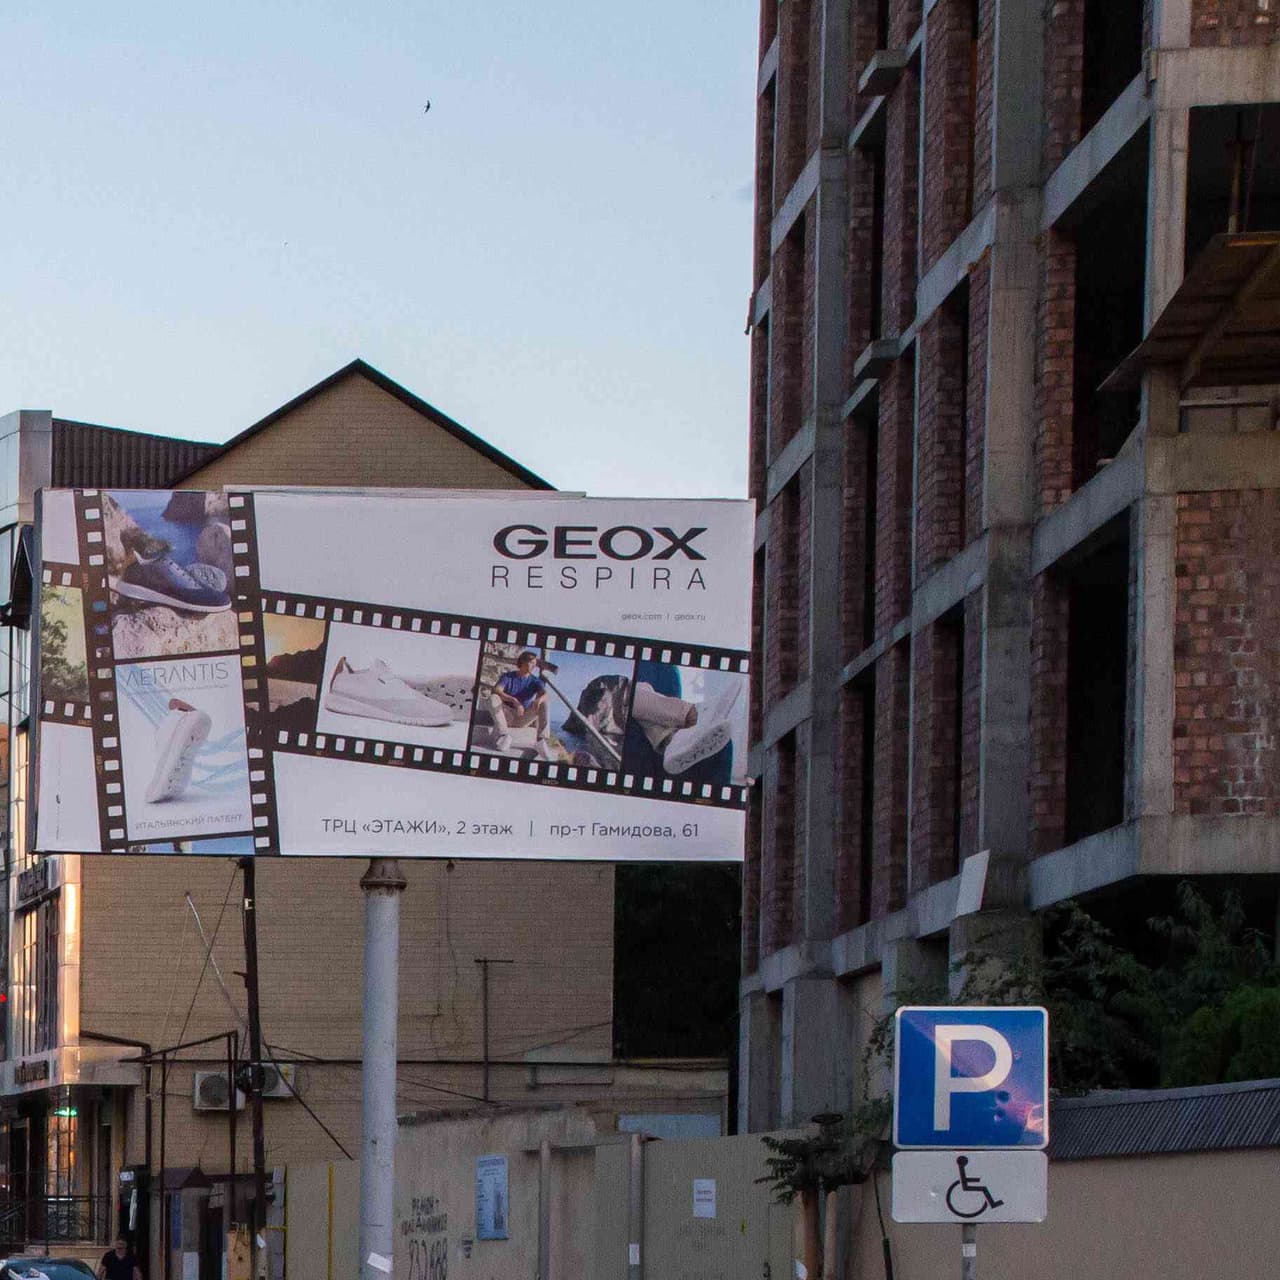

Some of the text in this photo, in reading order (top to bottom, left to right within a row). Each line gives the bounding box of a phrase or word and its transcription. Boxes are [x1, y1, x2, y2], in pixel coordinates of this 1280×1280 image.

[493, 524, 708, 561] GEOX
[492, 565, 706, 590] RESPIRA
[126, 662, 229, 687] AERANTIS
[321, 818, 699, 839] ТРЦ «ЭТАЖИ», 2 этаж пр-т Гамидова, 61
[933, 1024, 1013, 1131] P
